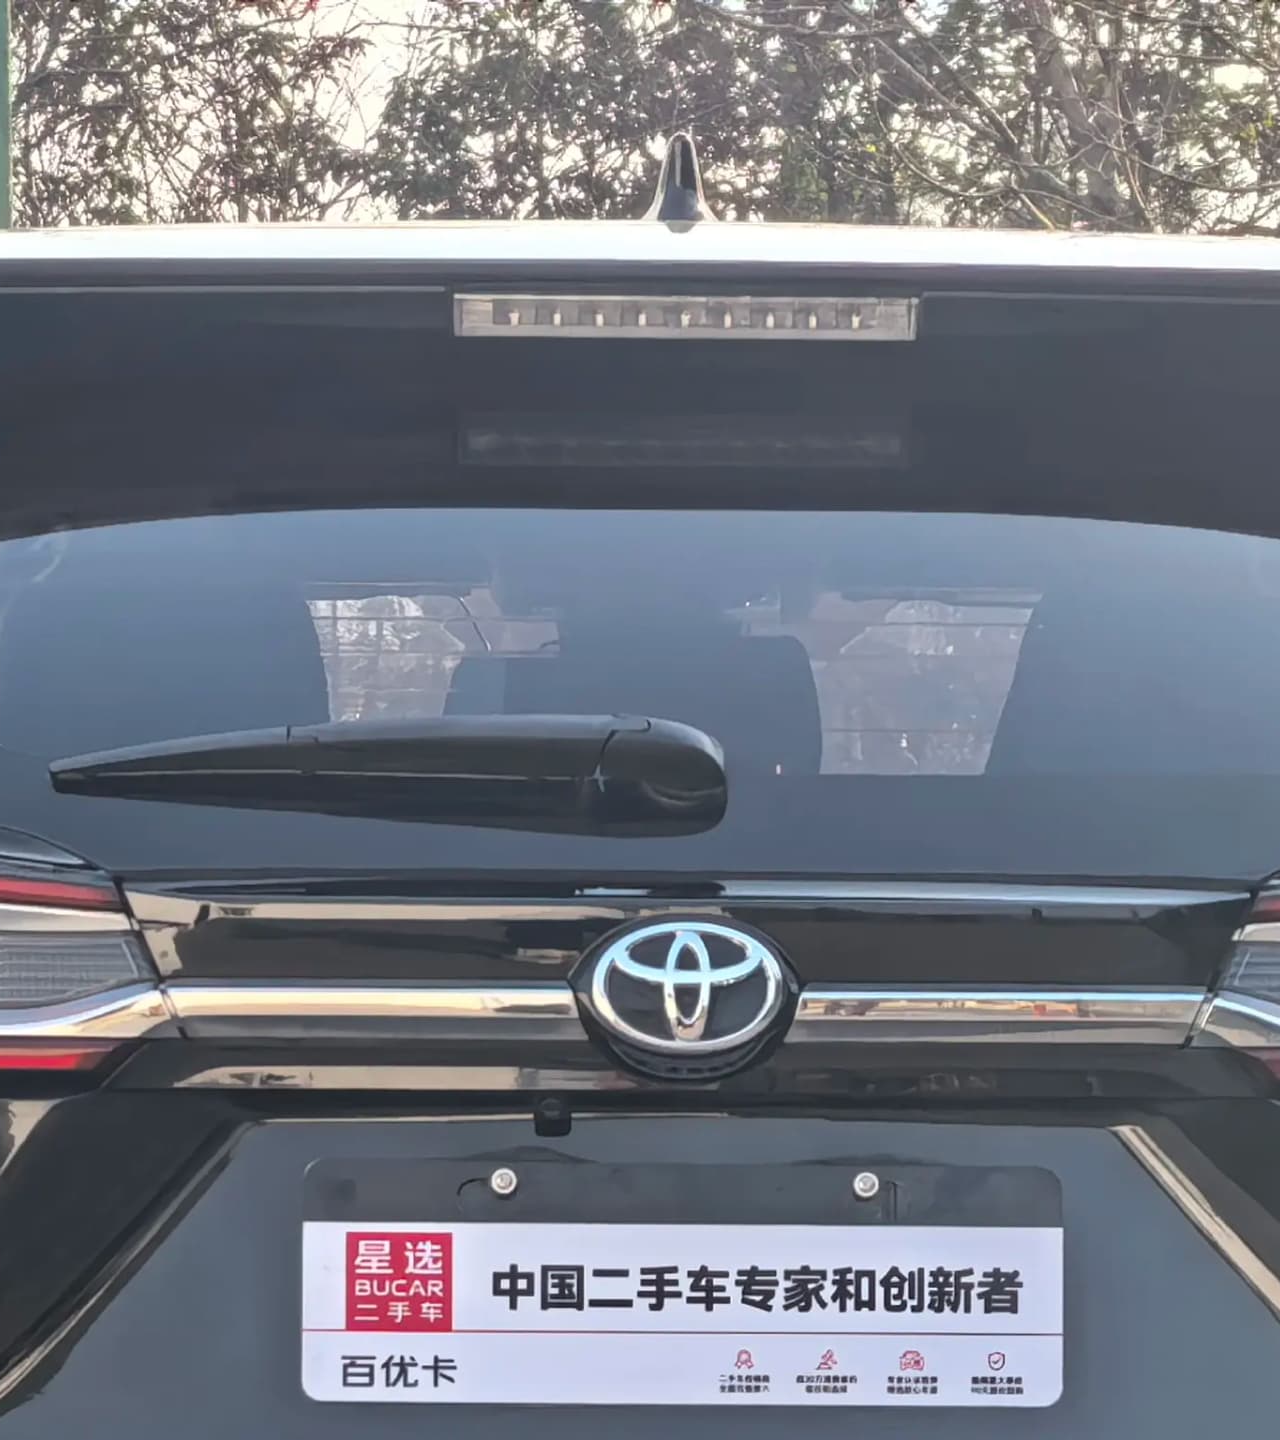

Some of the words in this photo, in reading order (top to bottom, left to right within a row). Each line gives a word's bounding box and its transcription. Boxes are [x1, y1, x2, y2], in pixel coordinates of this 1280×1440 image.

[354, 1240, 443, 1275] 星选
[354, 1279, 444, 1297] BUCAR
[492, 1263, 1024, 1315] 中国二手车专家和创新者
[354, 1301, 444, 1323] 二手车
[341, 1354, 458, 1388] 百优卡
